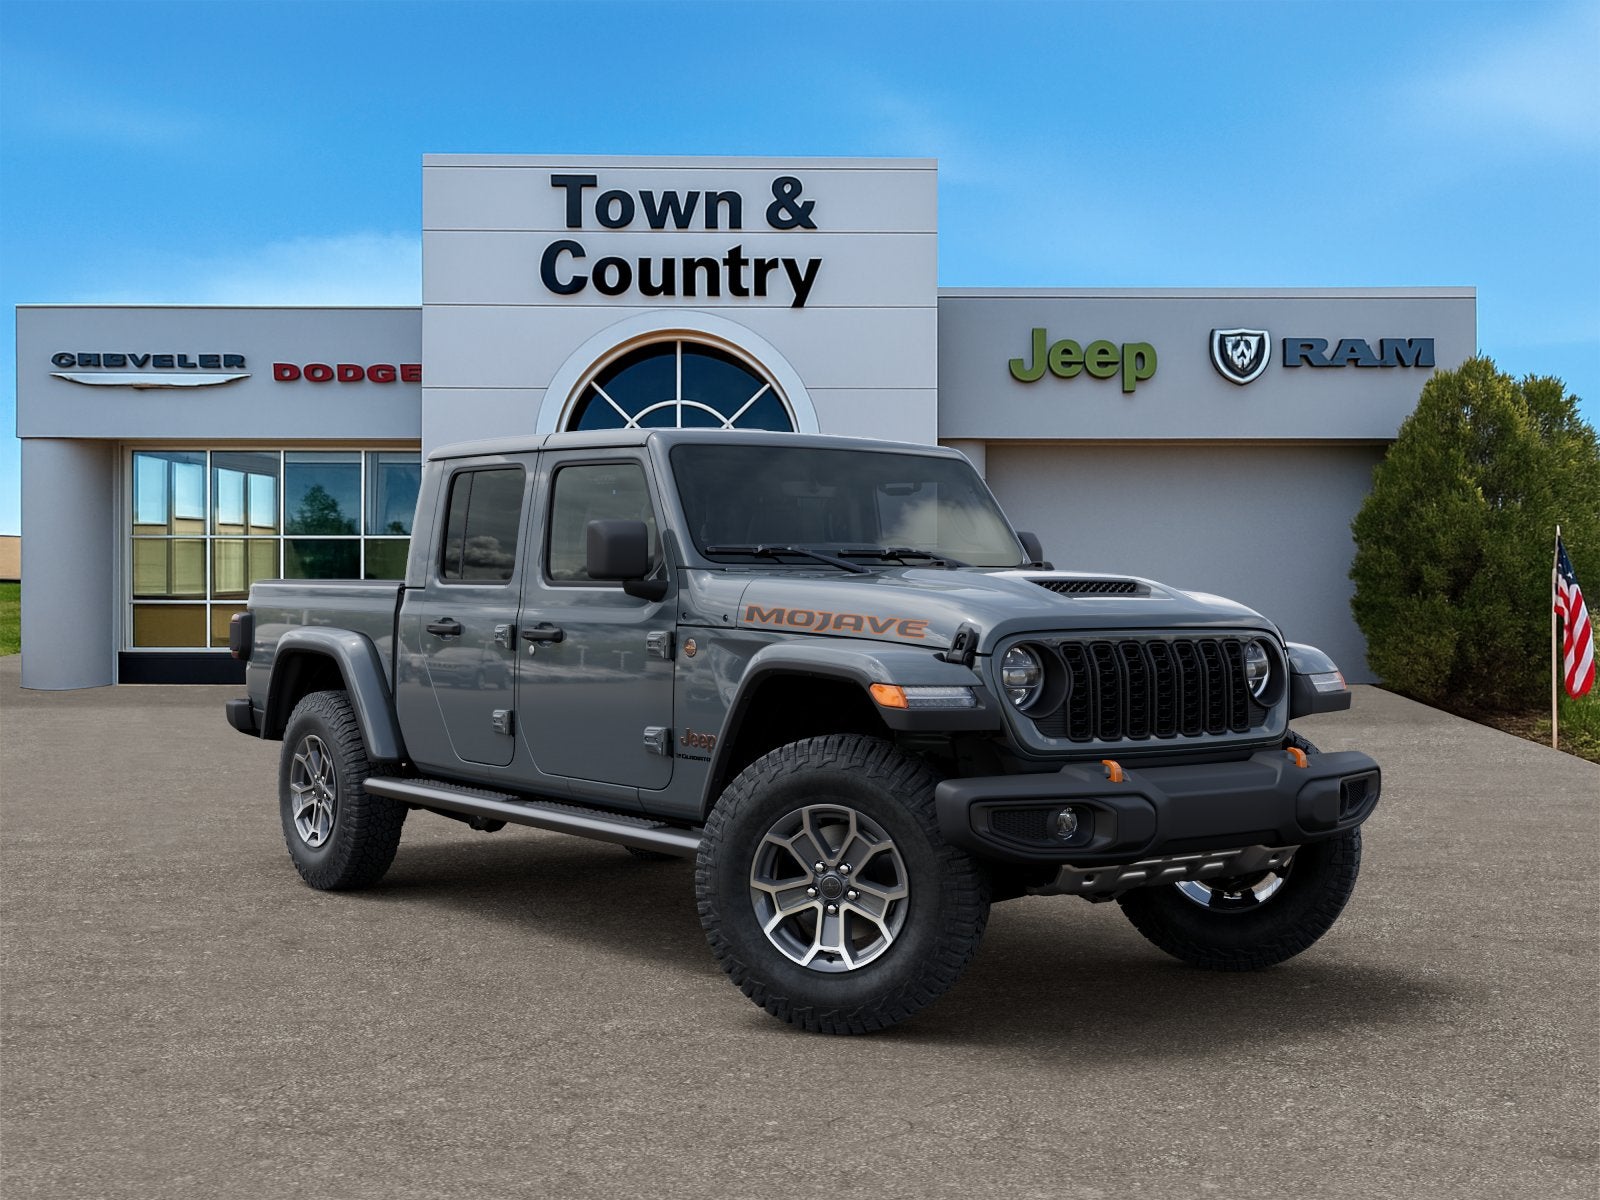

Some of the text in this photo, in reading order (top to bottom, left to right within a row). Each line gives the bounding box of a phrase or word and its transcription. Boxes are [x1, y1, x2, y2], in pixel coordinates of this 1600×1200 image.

[550, 174, 818, 230] Town &
[540, 239, 823, 308] Country
[1008, 327, 1158, 393] Jeep
[1282, 337, 1436, 368] RAM
[272, 362, 422, 383] DODGE
[745, 605, 929, 638] MOJAVE
[680, 727, 717, 753] Jeep
